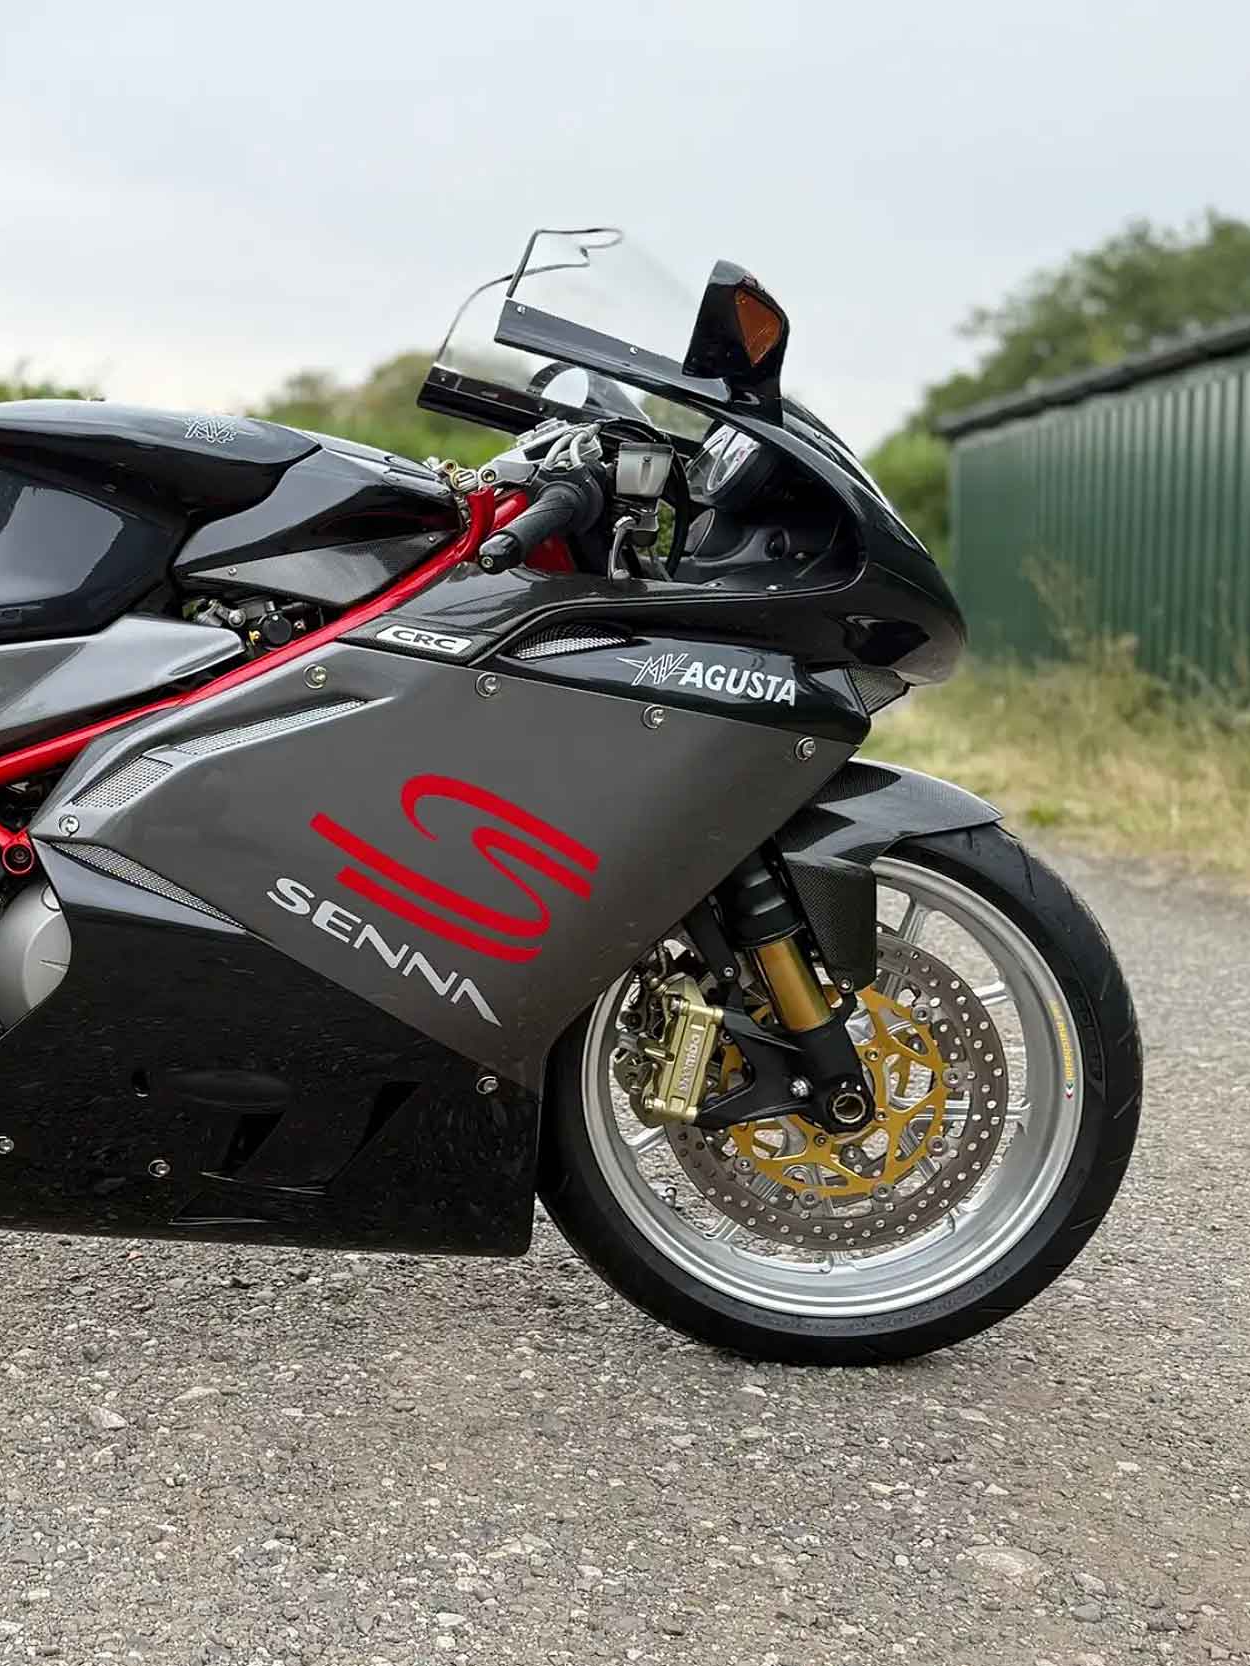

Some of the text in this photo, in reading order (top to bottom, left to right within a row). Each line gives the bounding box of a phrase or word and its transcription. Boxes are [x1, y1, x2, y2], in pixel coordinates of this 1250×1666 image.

[392, 630, 457, 650] CRC
[616, 652, 796, 707] MV AGUSTA
[266, 877, 502, 1028] SENNA
